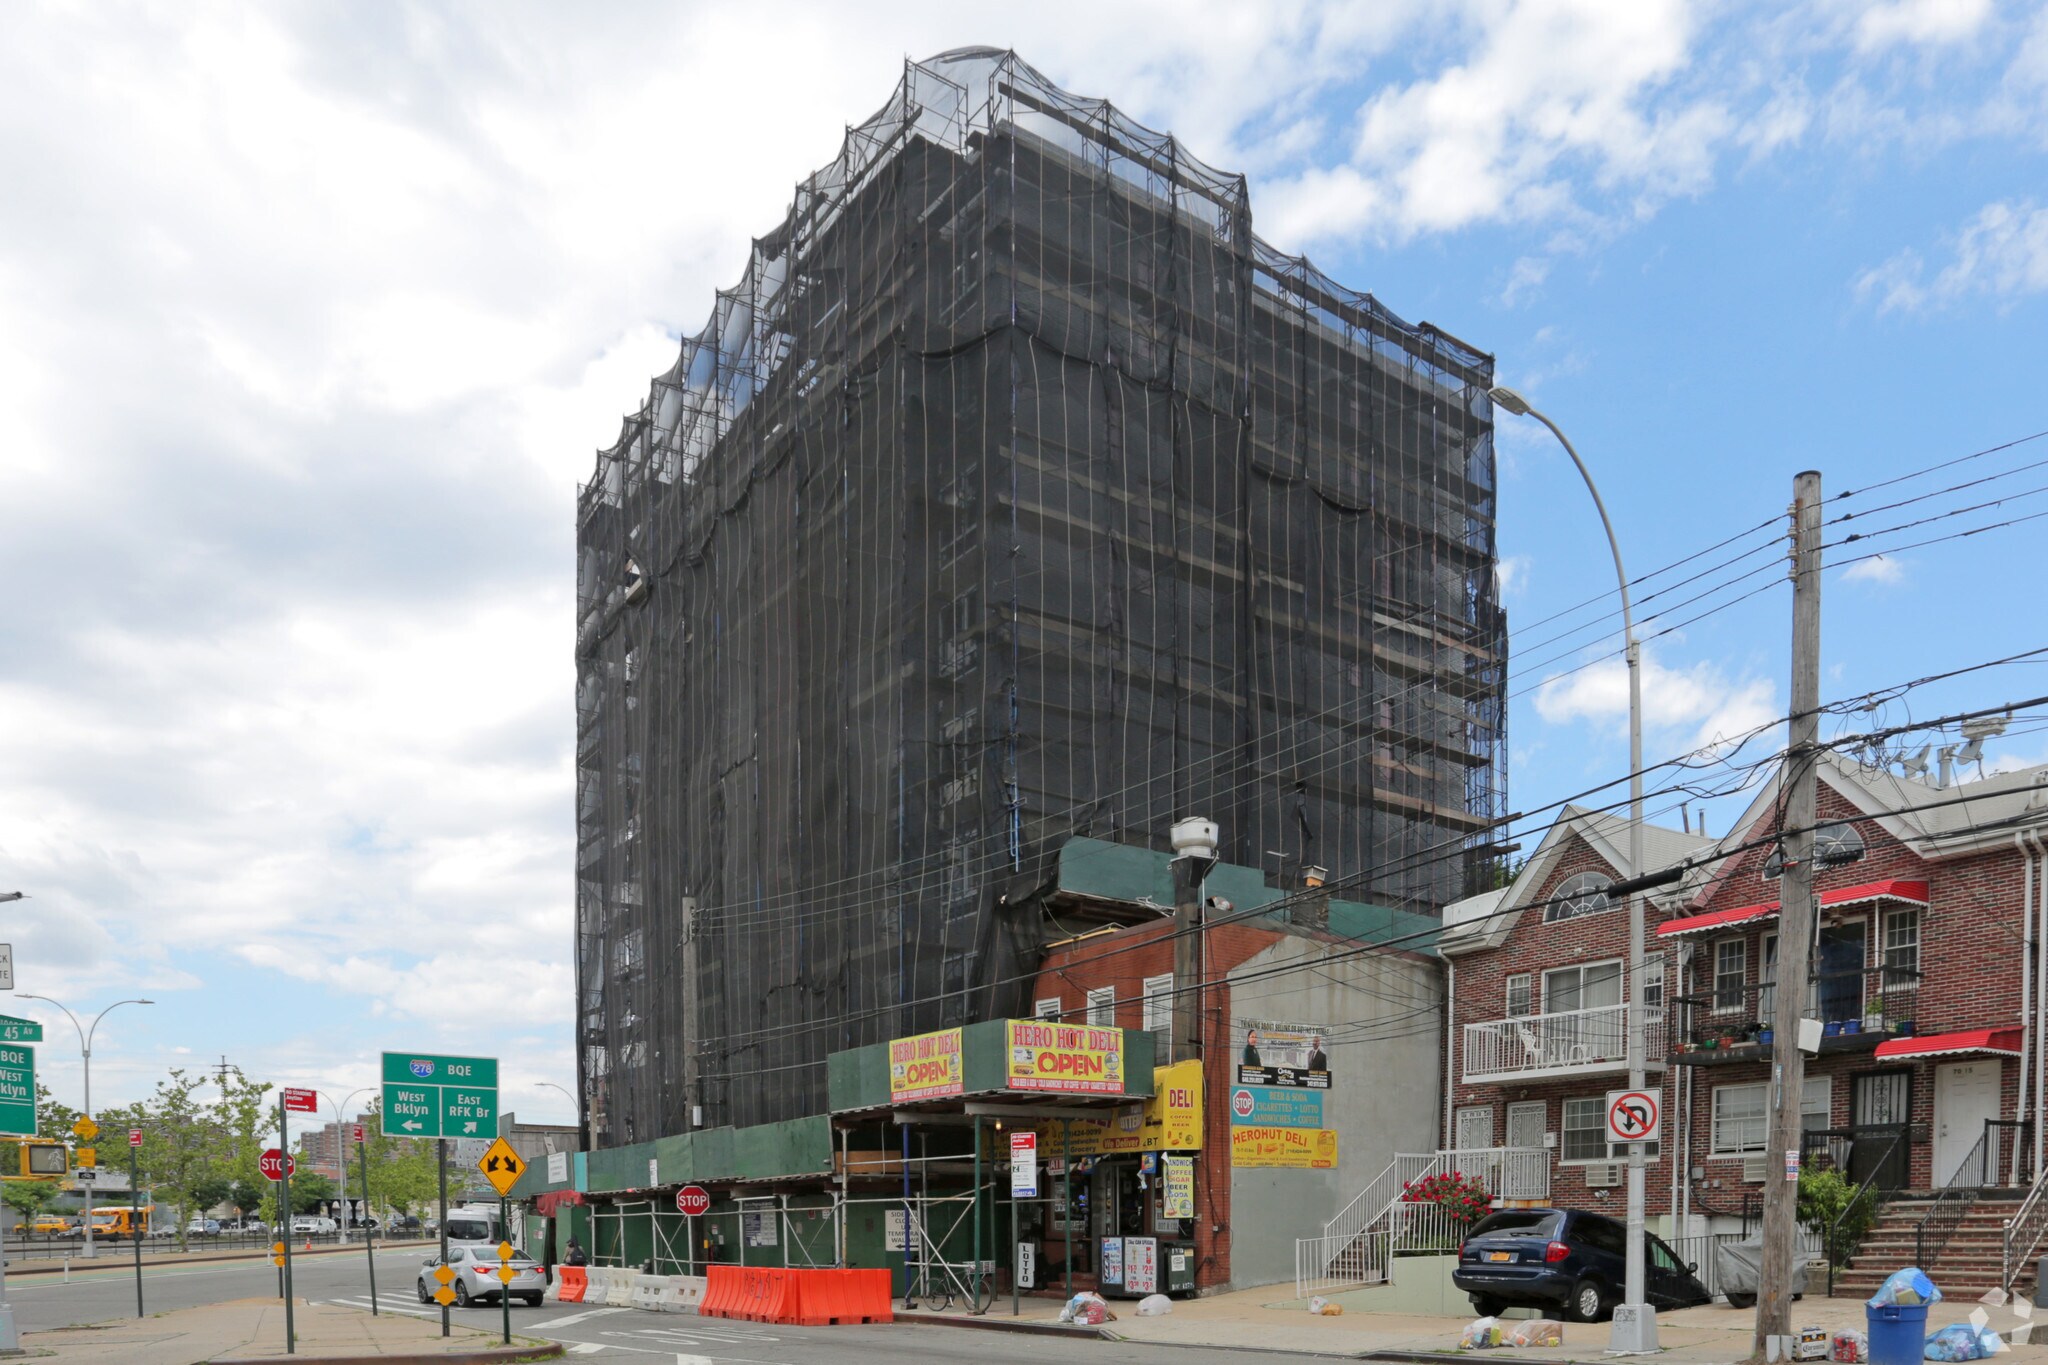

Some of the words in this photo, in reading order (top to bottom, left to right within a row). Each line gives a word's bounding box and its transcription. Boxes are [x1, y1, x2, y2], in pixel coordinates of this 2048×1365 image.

[4, 1026, 19, 1039] 45
[1013, 1025, 1052, 1048] HERO
[1088, 1030, 1119, 1052] DELI
[893, 1040, 916, 1063] HERO
[938, 1032, 960, 1055] DELI
[0, 1050, 24, 1064] BQE
[413, 1064, 432, 1074] 278
[447, 1064, 471, 1076] BQE
[1038, 1052, 1102, 1076] OPEN
[906, 1059, 948, 1084] OPEN
[397, 1091, 425, 1102] WEST
[457, 1094, 481, 1105] EAST
[1169, 1089, 1194, 1107] DELI
[1235, 1098, 1252, 1109] STOP
[394, 1103, 429, 1117] Bklyn
[449, 1106, 471, 1117] RFK
[476, 1107, 490, 1118] Br
[1104, 1139, 1114, 1148] We
[1115, 1138, 1138, 1148] Deliver
[1232, 1129, 1282, 1145] HEROHUT
[1285, 1131, 1307, 1147] DELI
[1070, 1145, 1096, 1154] Grocery
[1168, 1159, 1193, 1167] ANDWICH
[679, 1195, 707, 1207] STOP
